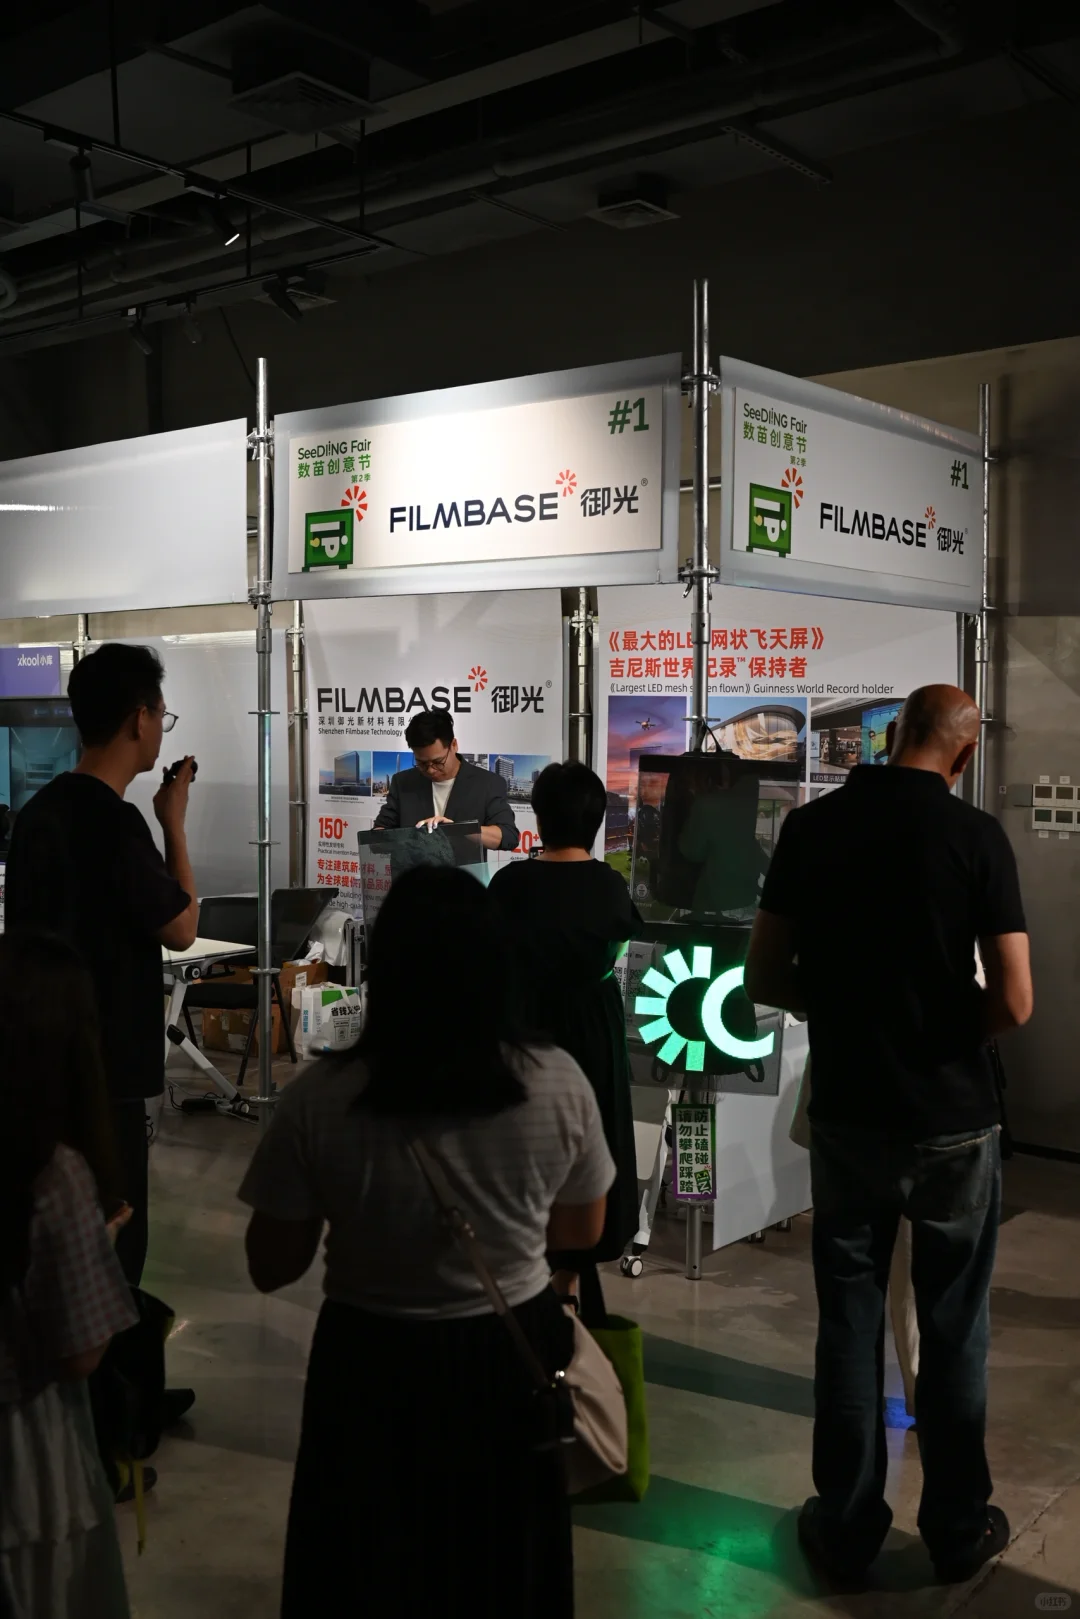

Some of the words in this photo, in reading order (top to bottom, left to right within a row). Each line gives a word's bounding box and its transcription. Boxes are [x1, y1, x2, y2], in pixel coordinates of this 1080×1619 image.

[607, 397, 650, 434] #1
[790, 416, 808, 434] Fair
[350, 438, 372, 454] Fair
[743, 420, 807, 454] 数苗创意节
[297, 453, 372, 479] 数苗创意节
[789, 455, 807, 468] 第2季
[951, 459, 969, 490] #1
[350, 473, 371, 483] 第2季
[389, 491, 558, 533] FILMBASE
[819, 502, 927, 548] FILMBASE
[608, 627, 824, 652] 《最大的LE网状飞天屏》
[317, 686, 472, 714] FILMBASE
[647, 683, 663, 692] LED
[665, 683, 688, 693] mesh
[753, 683, 795, 694] Guinness
[797, 683, 824, 694] World
[826, 684, 860, 694] Record
[862, 683, 894, 694] holder
[318, 716, 411, 727] 深圳御光新材料有限
[318, 727, 345, 735] Shenzhen
[370, 729, 403, 737] Technology
[694, 1110, 709, 1165] 防止磕碰
[679, 1110, 694, 1193] 请勿攀爬踩踏
